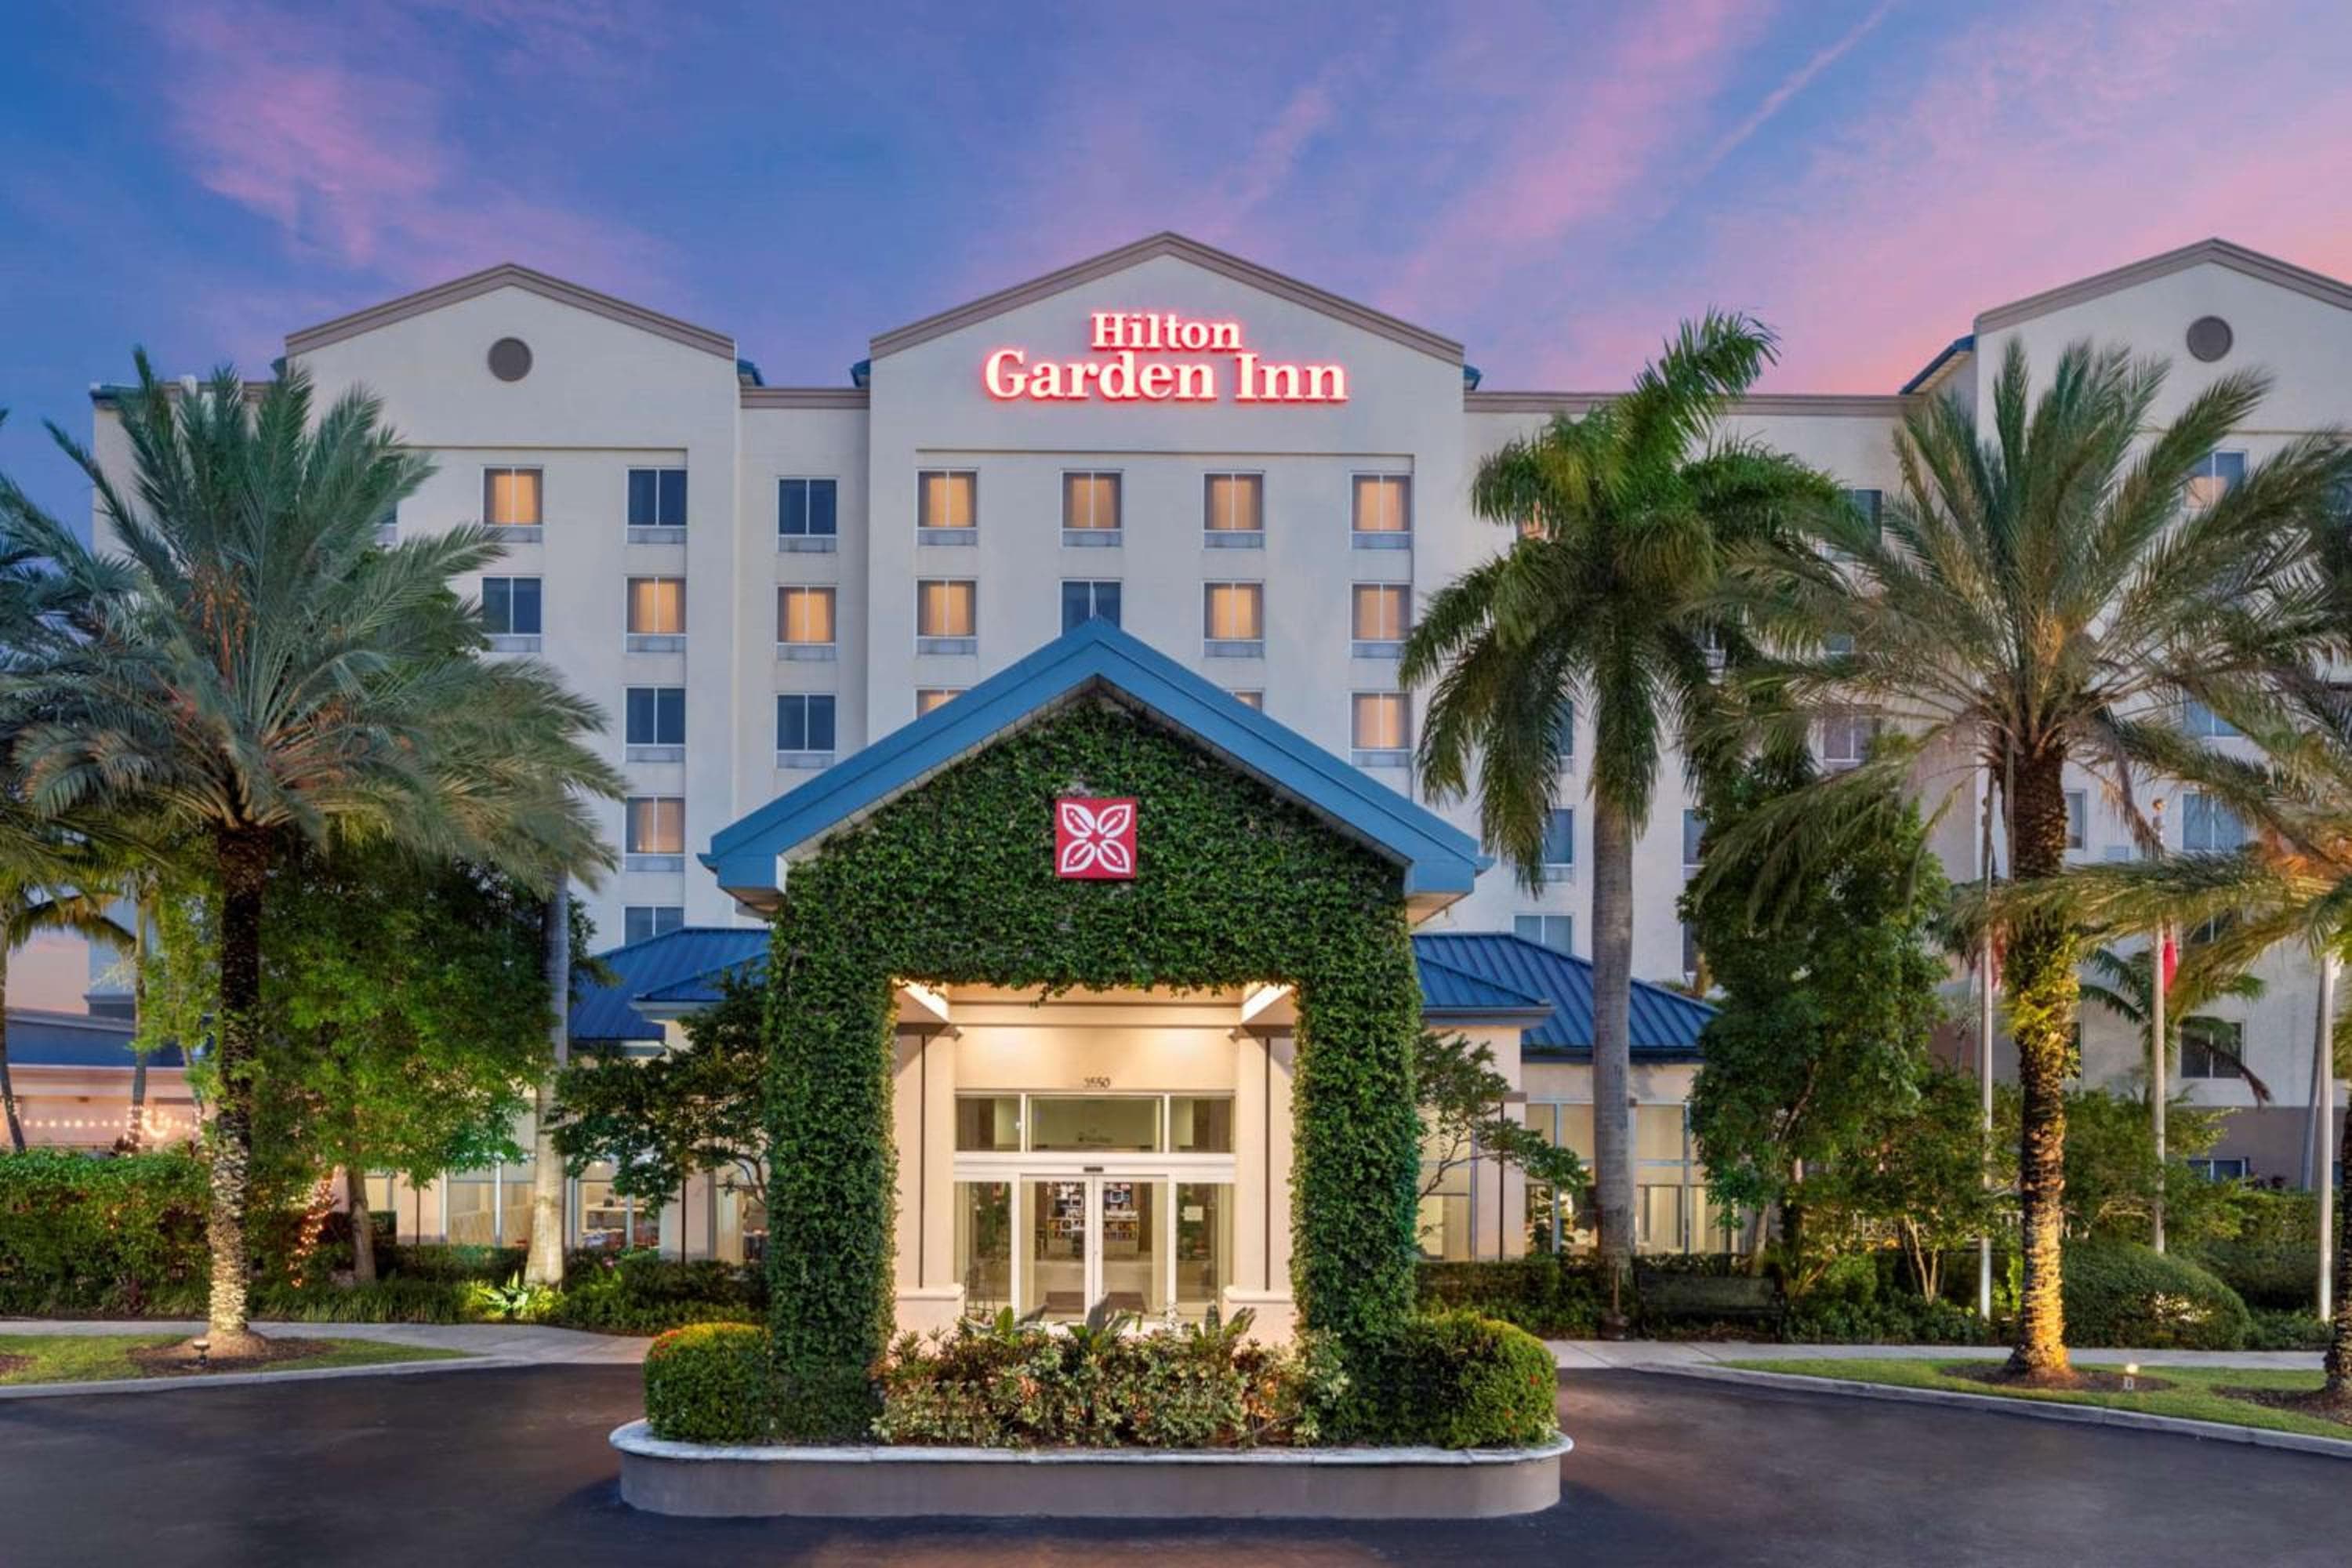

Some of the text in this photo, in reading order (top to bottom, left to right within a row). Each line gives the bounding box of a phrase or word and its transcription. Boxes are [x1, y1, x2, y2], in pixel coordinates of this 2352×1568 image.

[1091, 313, 1242, 350] Hilton
[985, 349, 1348, 401] Garden Inn
